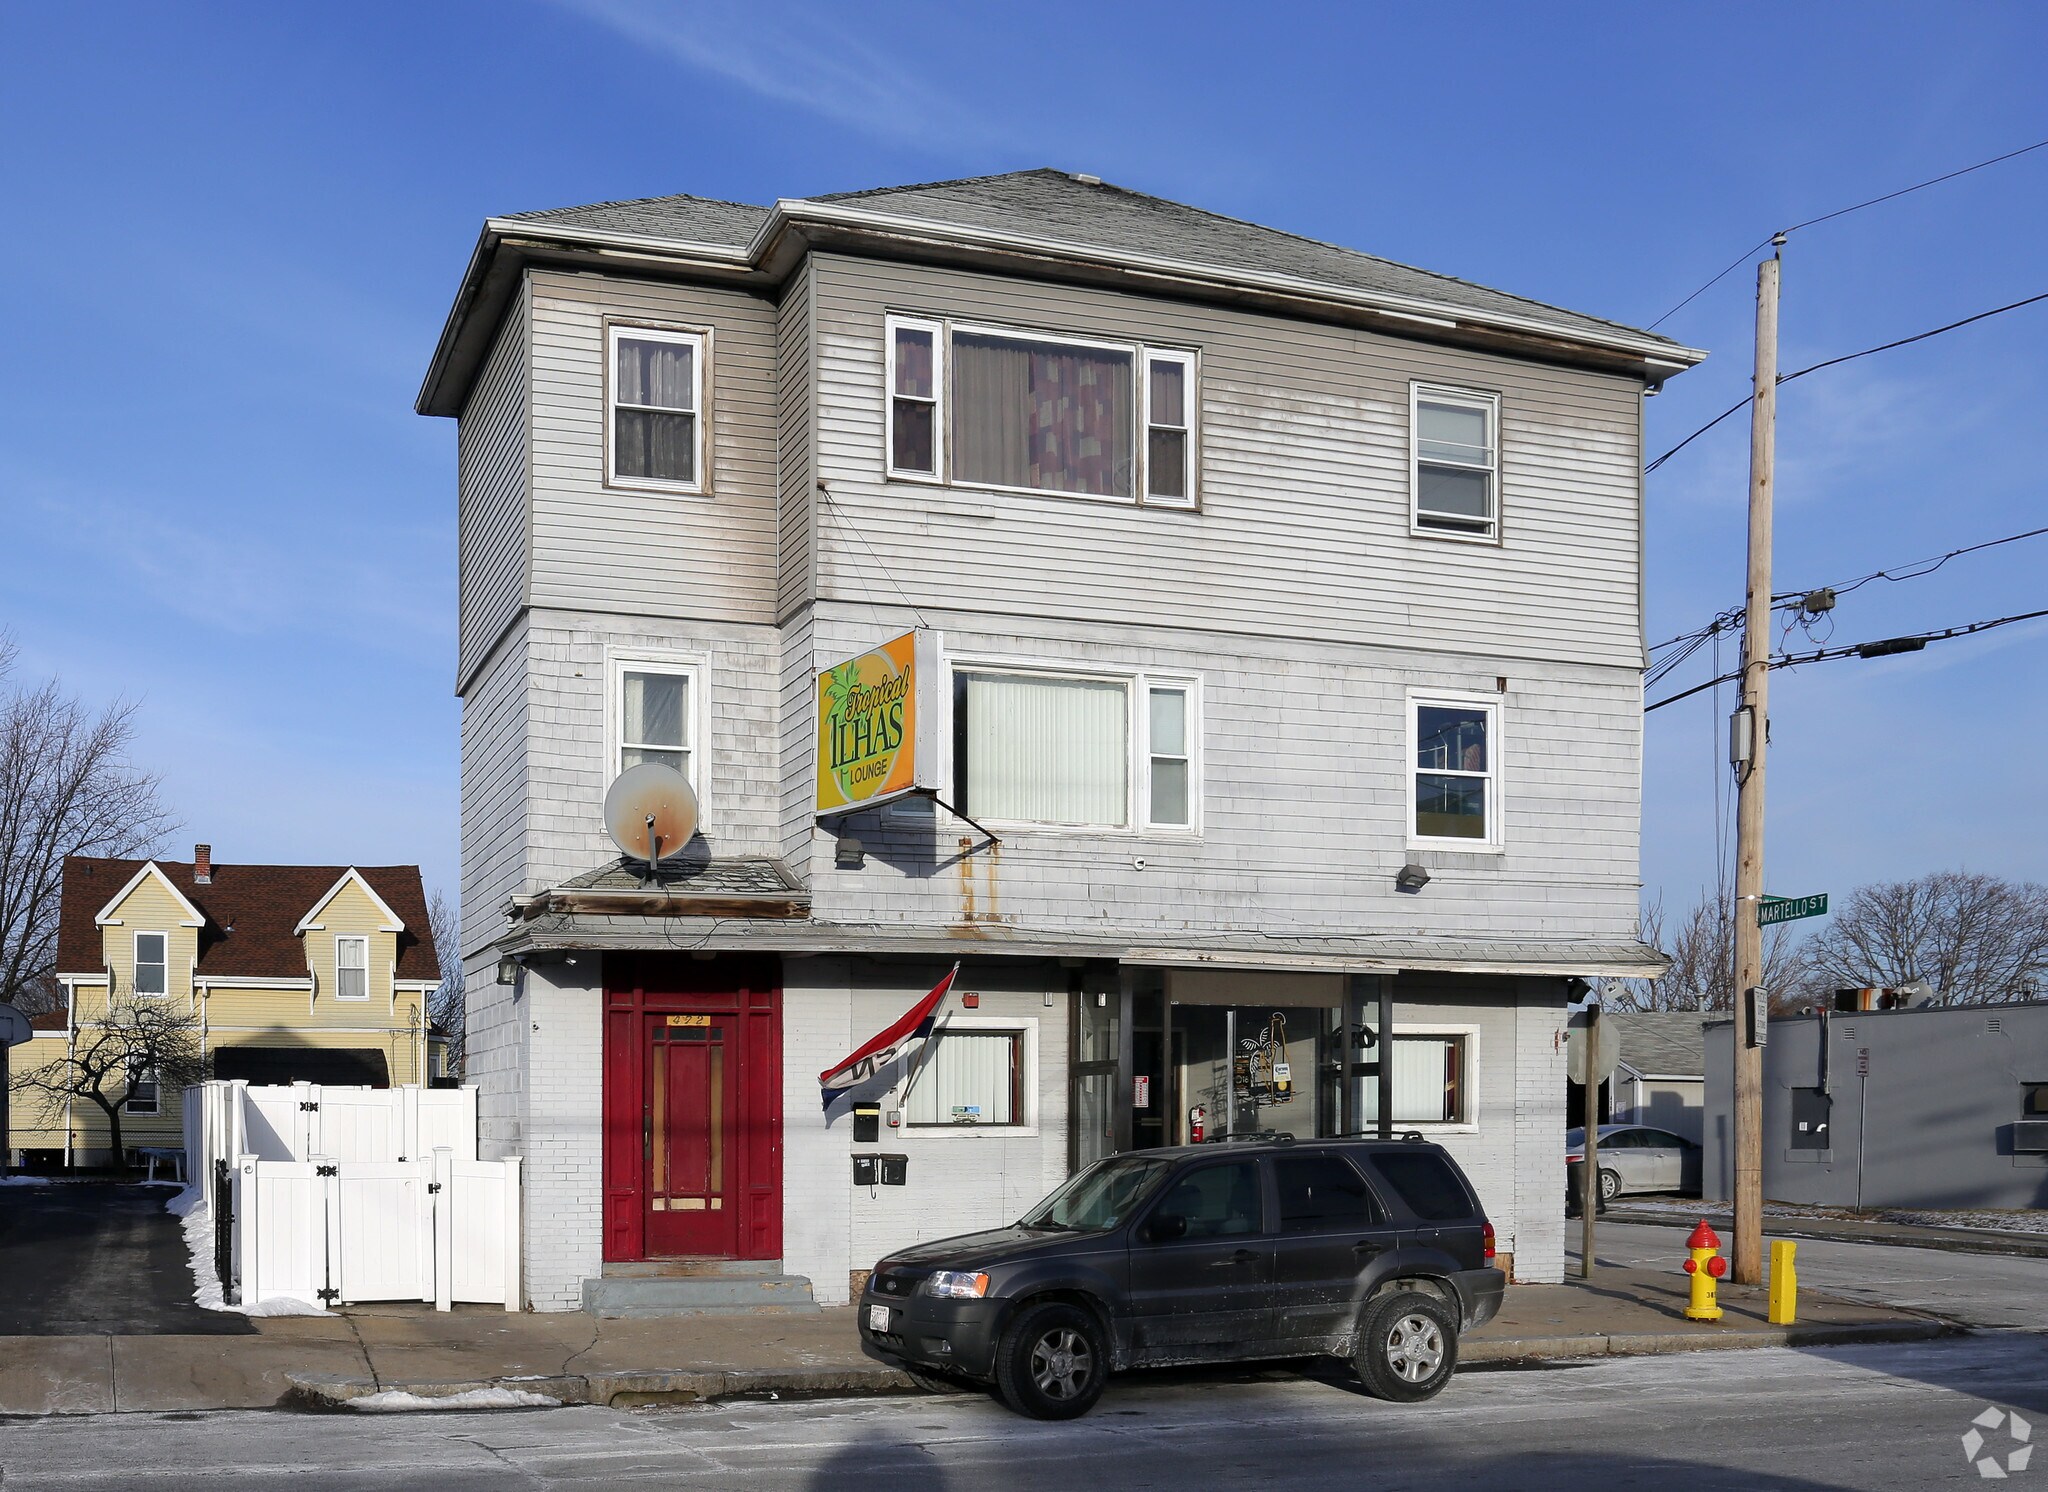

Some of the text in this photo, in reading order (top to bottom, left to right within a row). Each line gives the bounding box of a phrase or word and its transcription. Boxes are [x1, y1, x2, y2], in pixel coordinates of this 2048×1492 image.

[845, 664, 910, 722] Tropical
[830, 702, 904, 770] ILHAS
[849, 759, 888, 786] LOUNGE
[1761, 895, 1826, 923] MARTELLO ST
